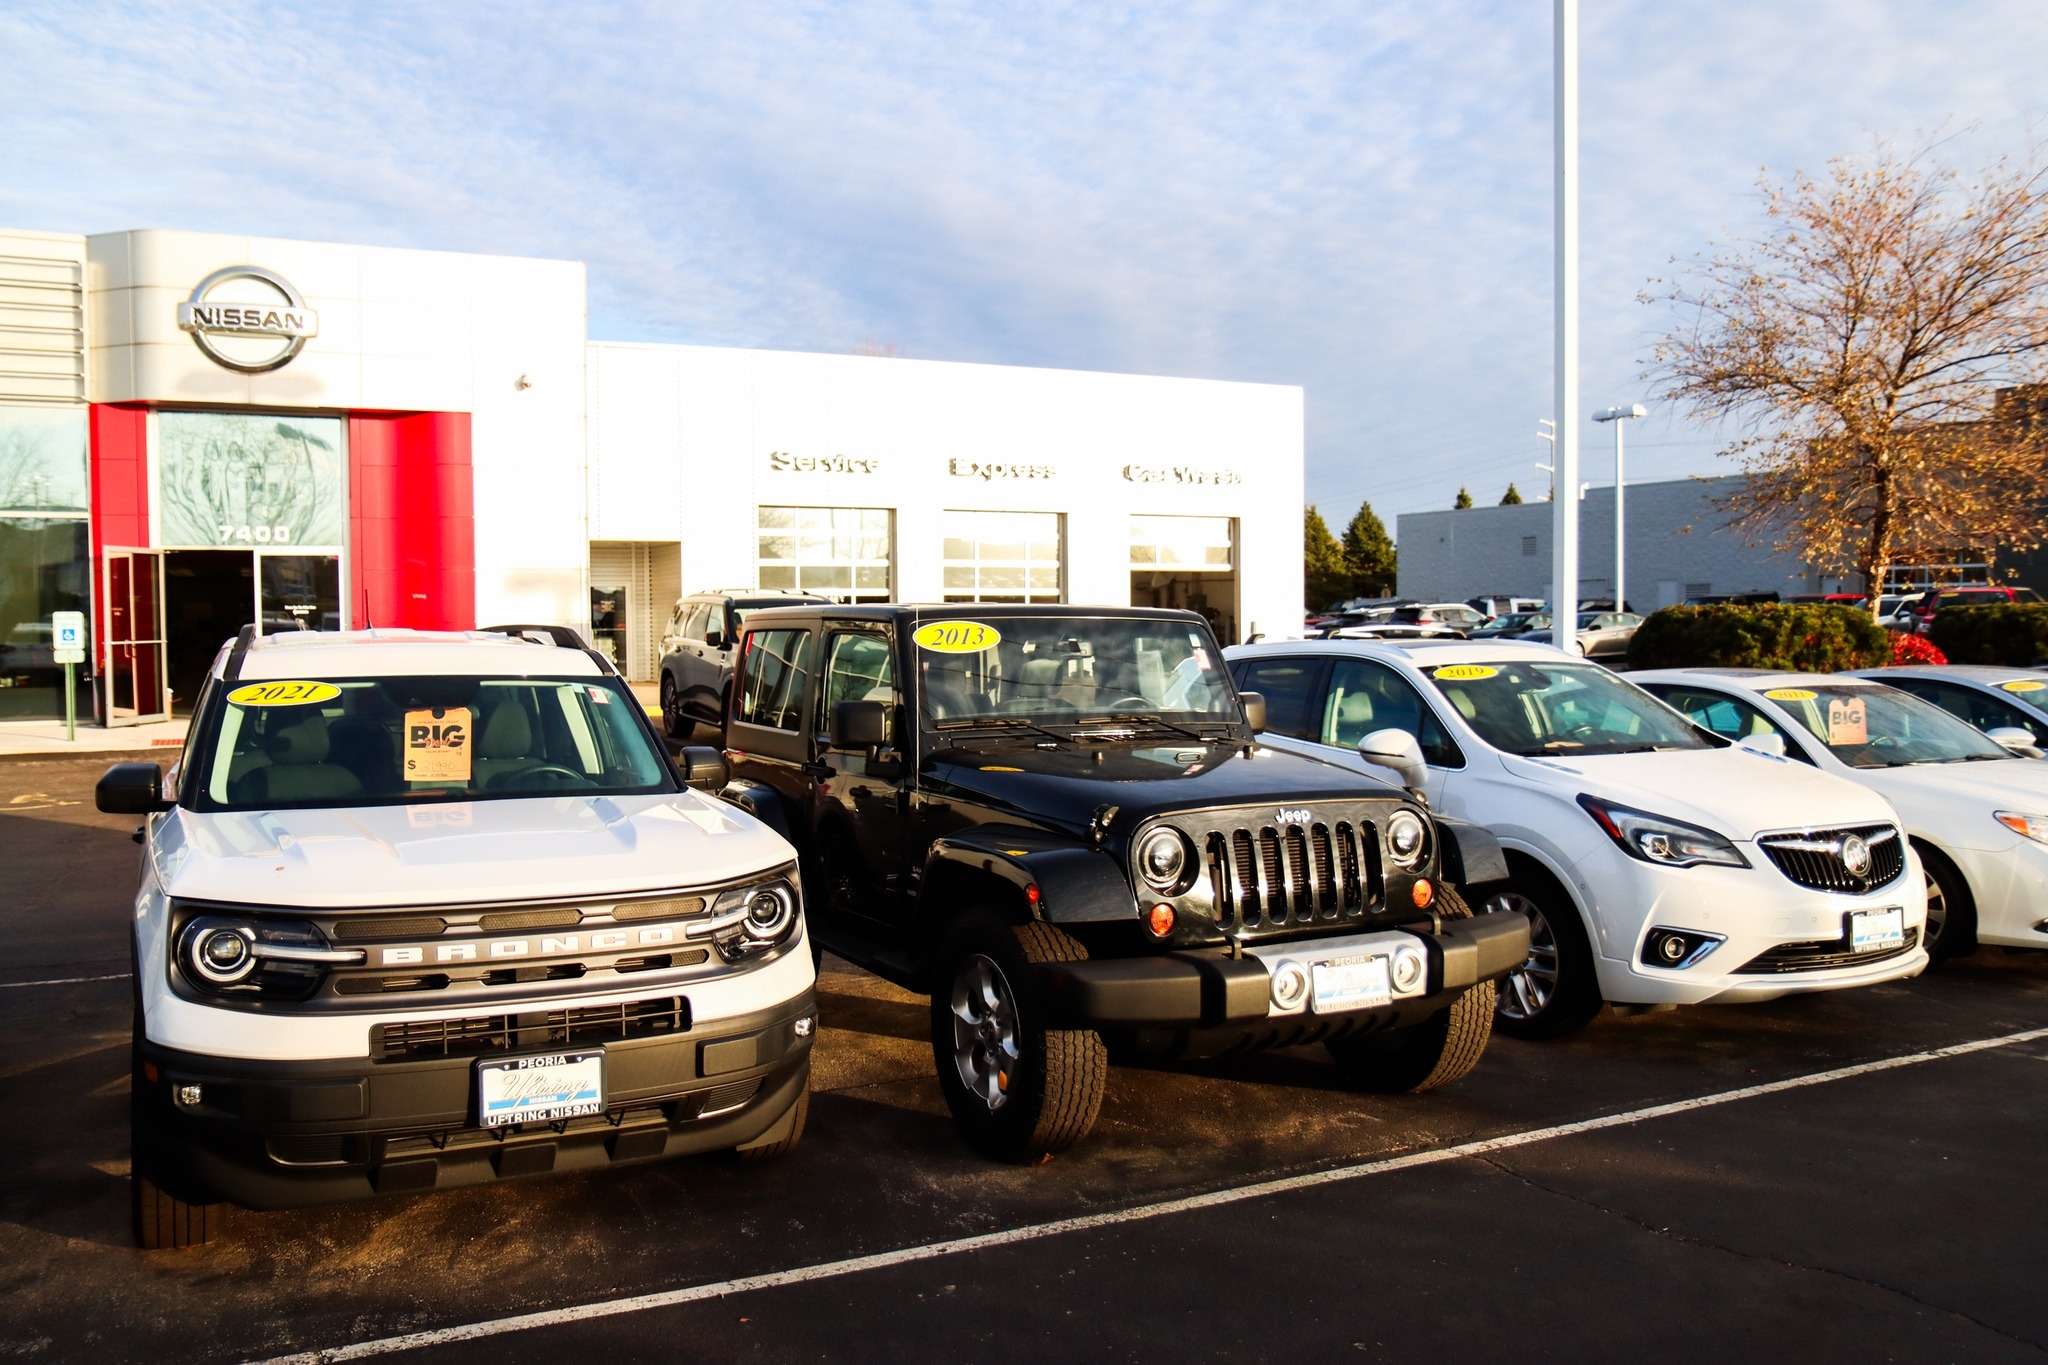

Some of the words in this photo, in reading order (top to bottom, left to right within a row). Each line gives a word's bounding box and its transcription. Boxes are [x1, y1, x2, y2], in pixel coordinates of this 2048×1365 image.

[190, 307, 304, 330] NISSAN
[218, 525, 290, 542] 7400
[931, 627, 985, 646] 2013
[1447, 666, 1484, 678] 2019
[243, 685, 320, 702] 2021
[1832, 710, 1862, 725] BIG
[411, 725, 466, 748] BIG
[1275, 808, 1311, 824] Jeep
[382, 927, 673, 965] BRONCO
[1334, 956, 1366, 966] PEORIA
[518, 1055, 567, 1070] PEORIA
[528, 1094, 558, 1104] NISSAN
[487, 1109, 547, 1126] UFTRING
[550, 1103, 600, 1118] NISSAN
